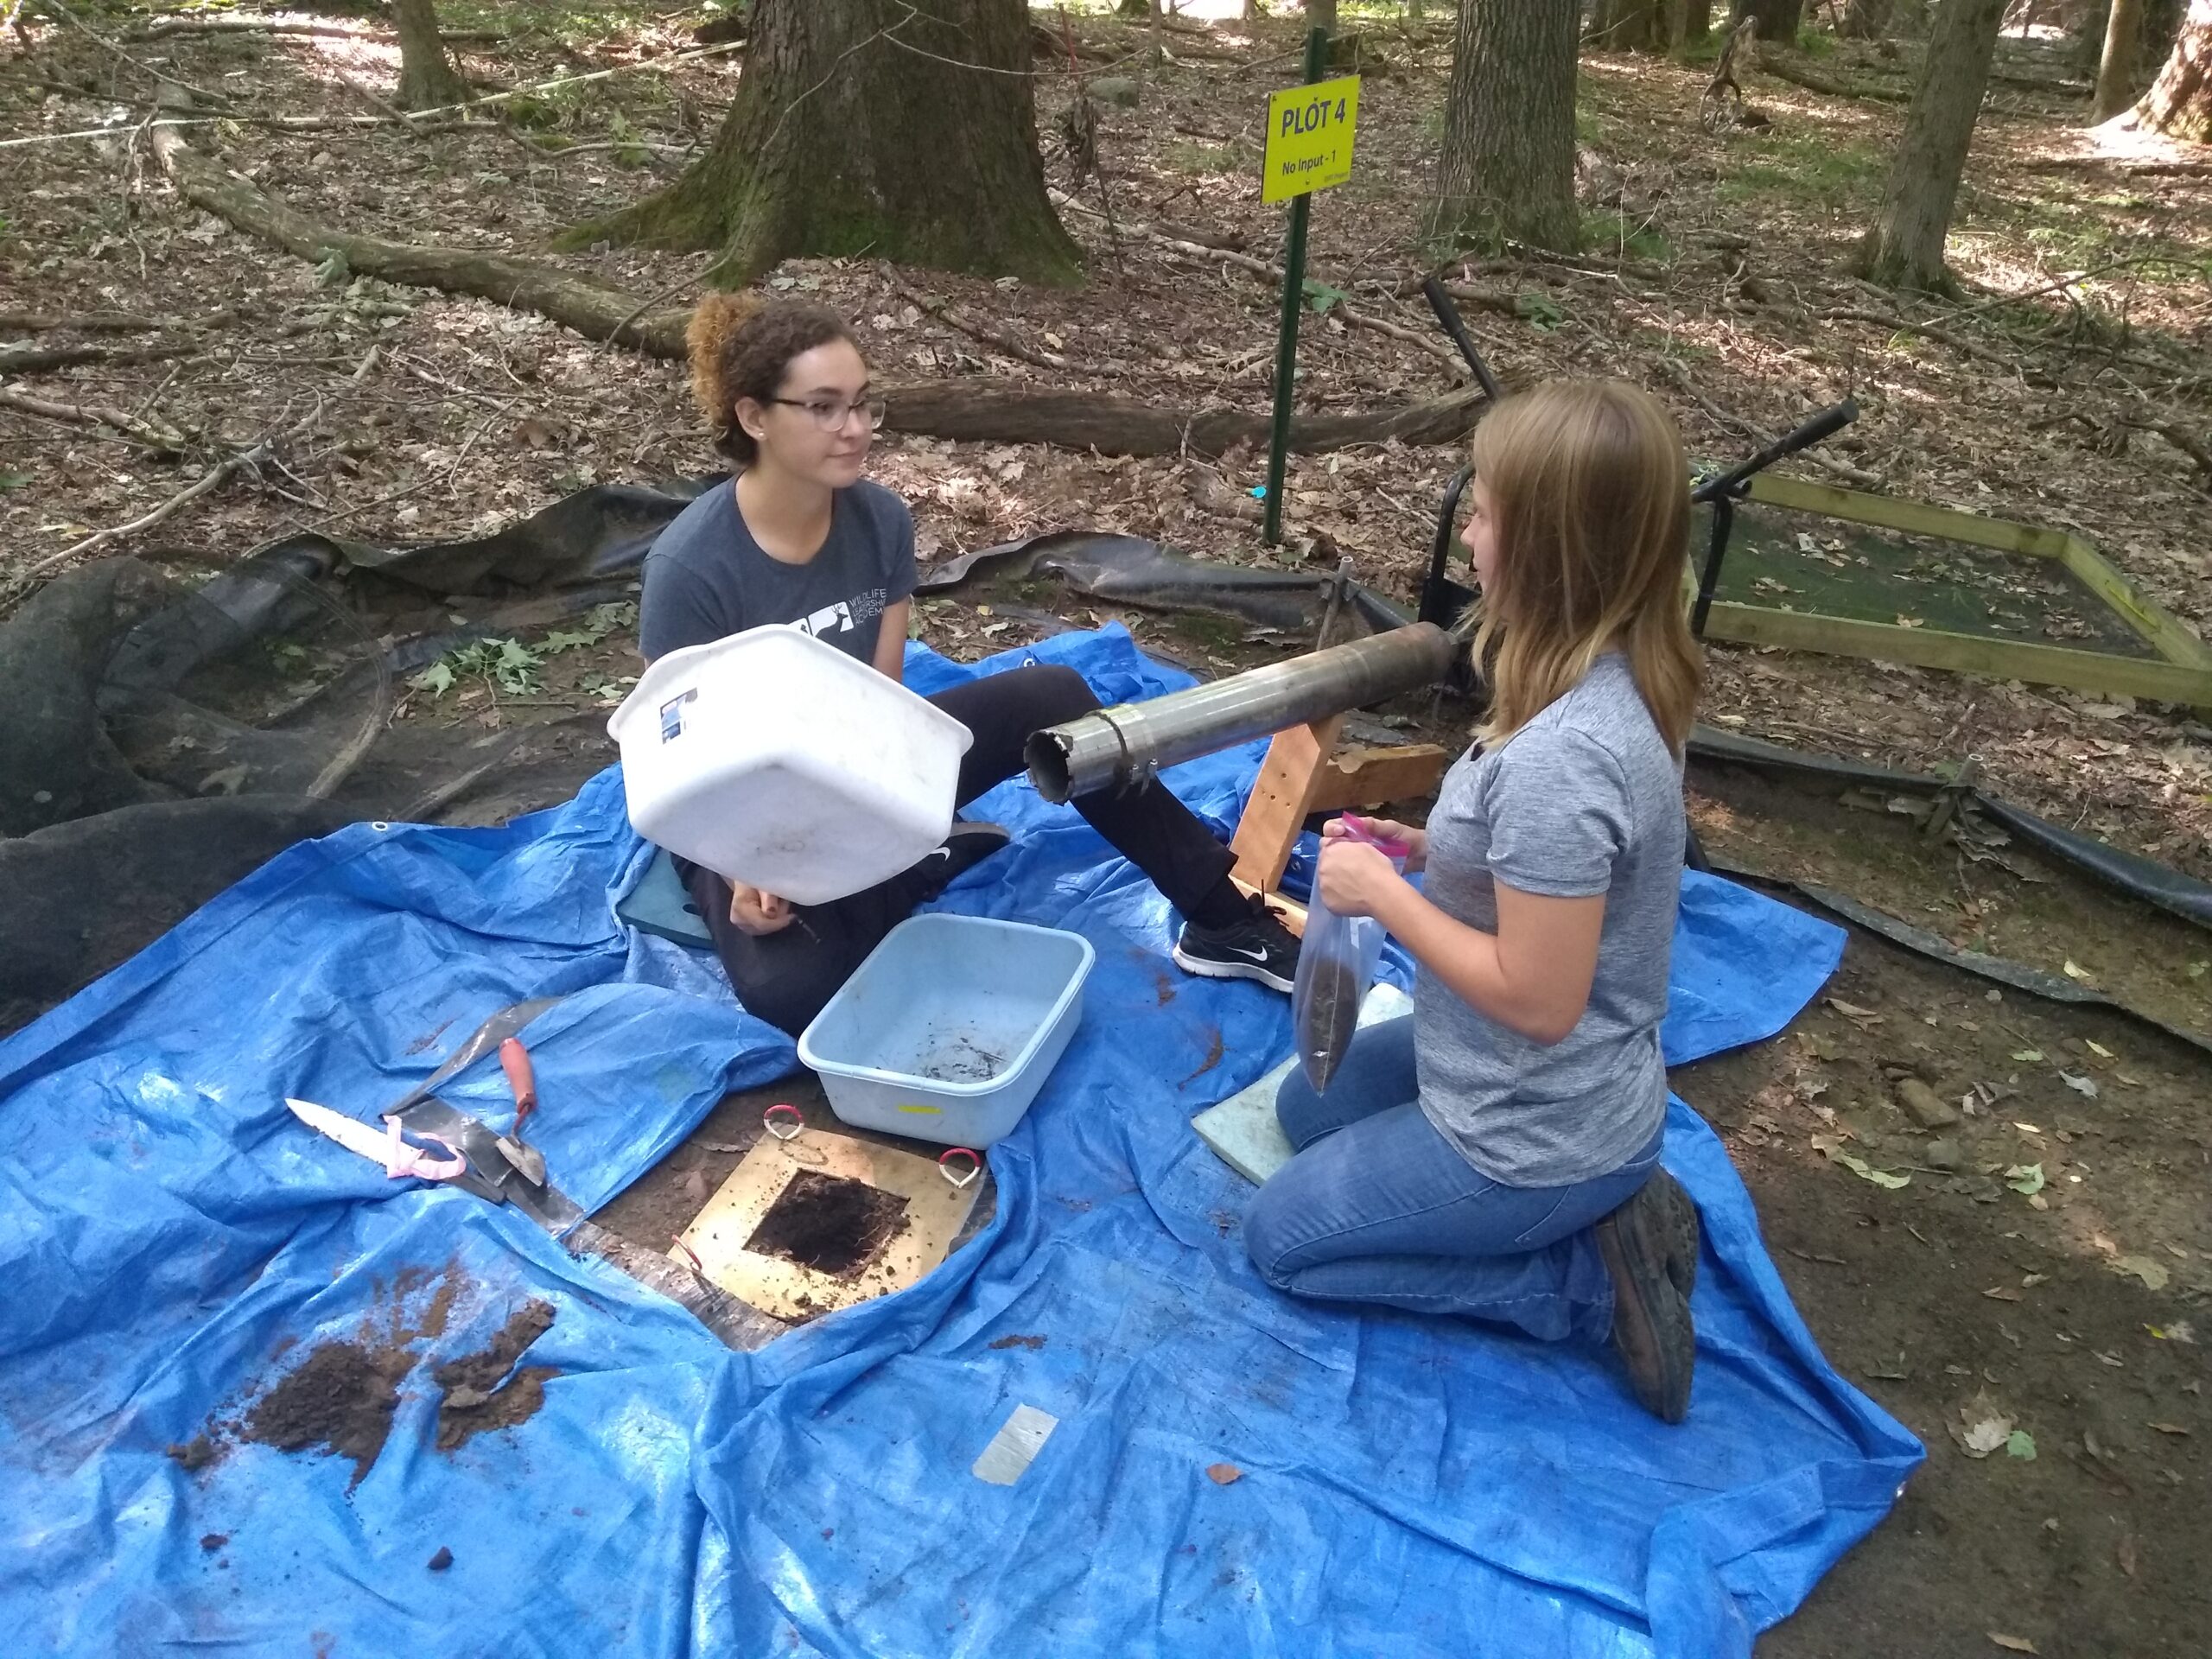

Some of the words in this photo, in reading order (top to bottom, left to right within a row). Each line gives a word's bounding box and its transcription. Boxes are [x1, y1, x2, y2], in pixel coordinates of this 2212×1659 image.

[1281, 100, 1332, 137] PLOT
[1334, 98, 1345, 124] 4
[1282, 161, 1296, 175] No
[1298, 155, 1324, 173] Input
[1332, 149, 1336, 162] 1
[849, 588, 887, 607] WILDLIFE
[852, 598, 886, 617] LEARSHI
[855, 607, 883, 625] ACDEM
